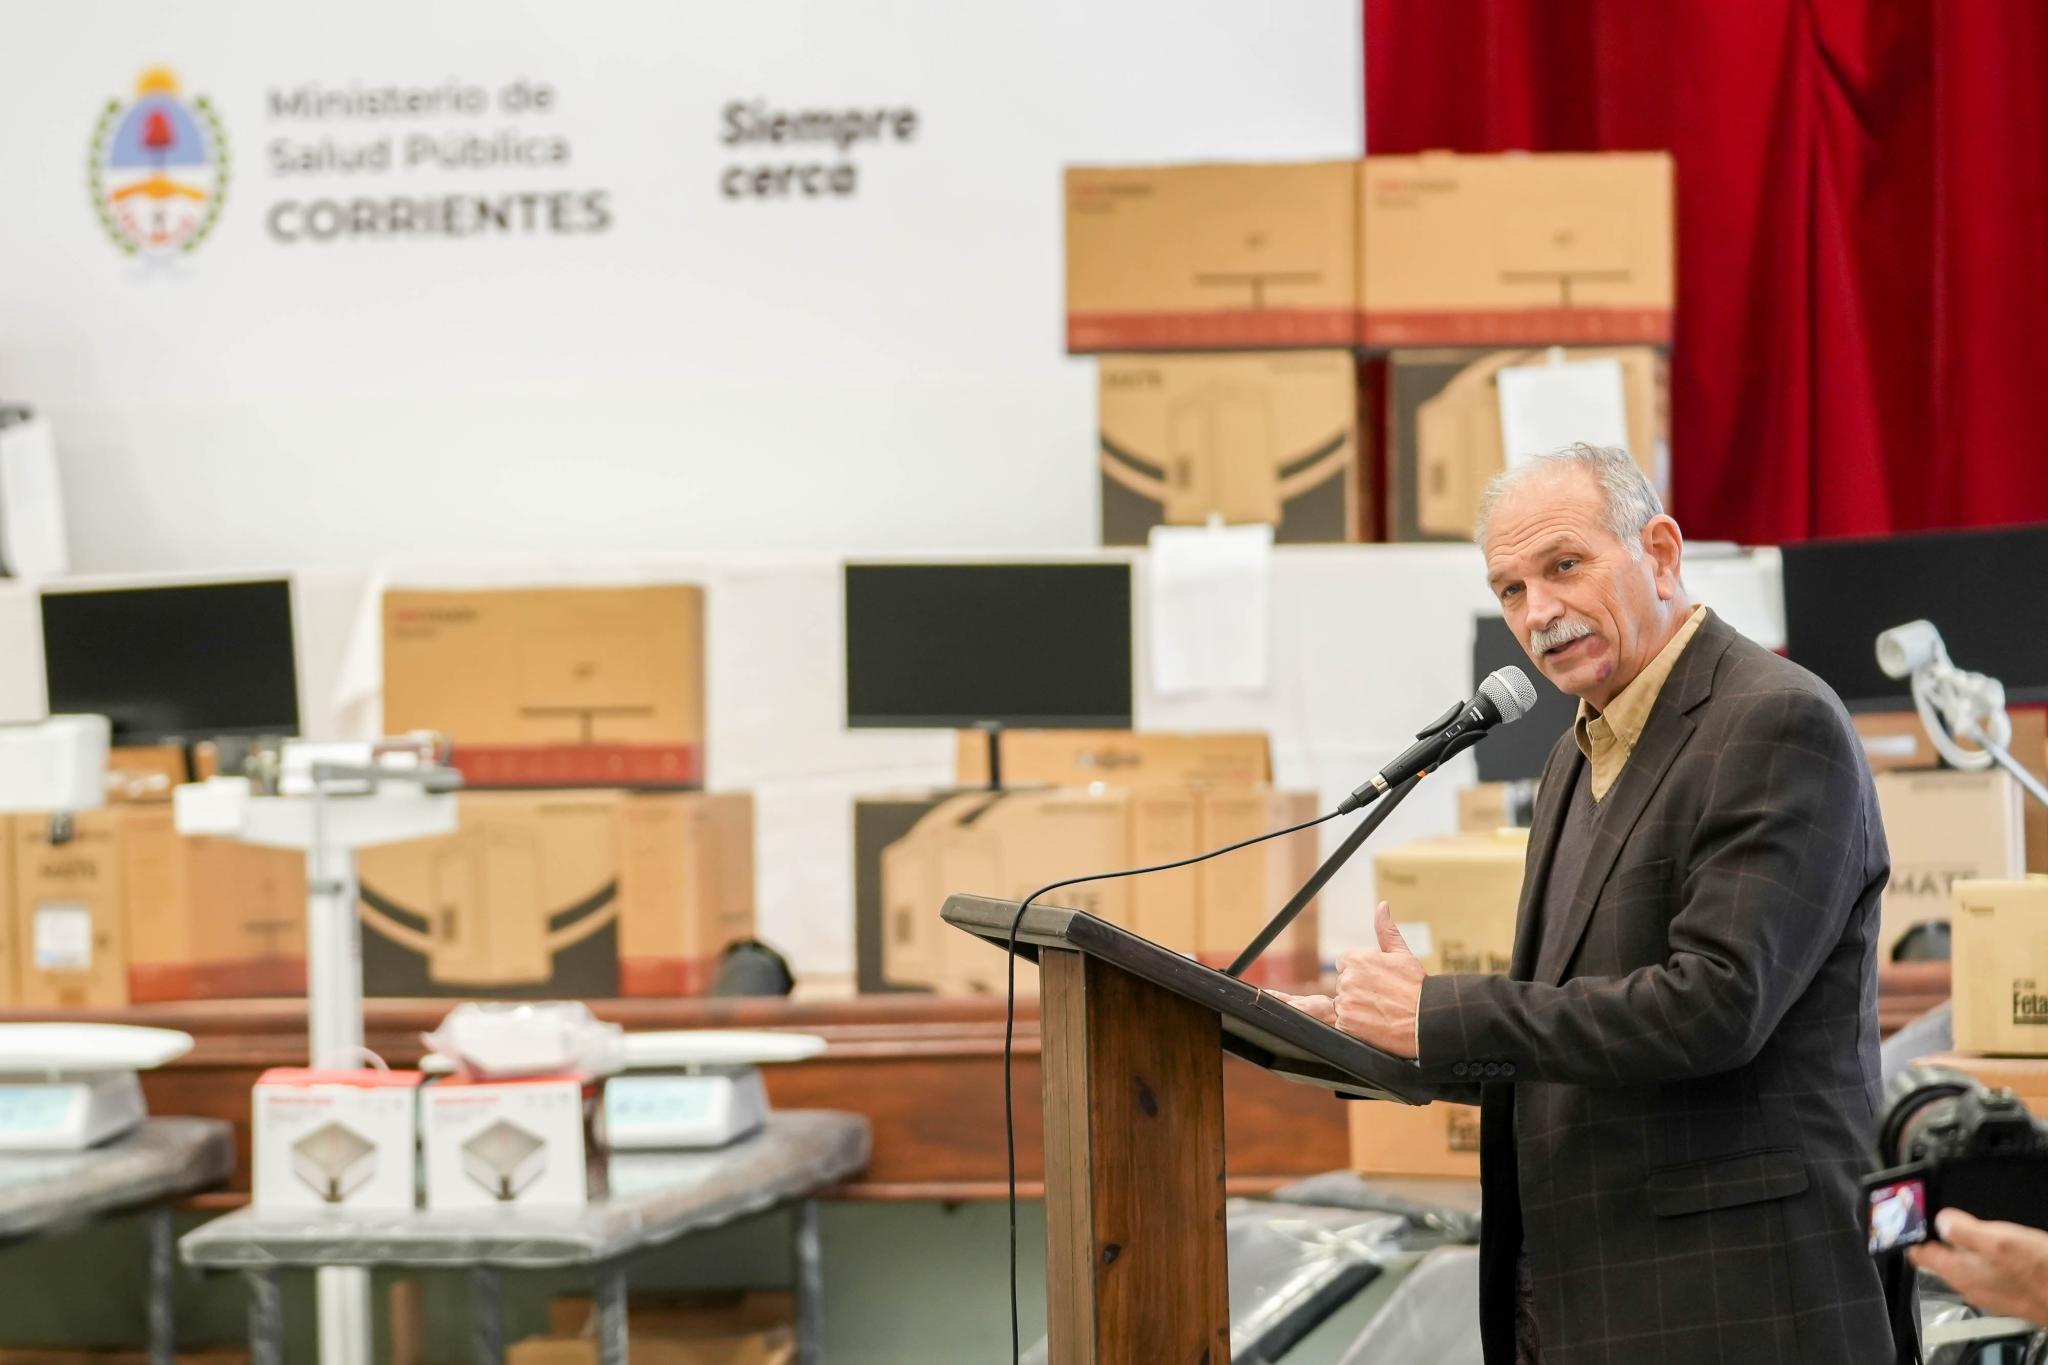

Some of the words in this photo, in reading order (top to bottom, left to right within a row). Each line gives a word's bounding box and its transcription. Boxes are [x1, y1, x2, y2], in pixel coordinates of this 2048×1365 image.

[267, 84, 489, 119] Ministerio
[498, 80, 556, 114] de
[720, 99, 921, 157] Siempre
[267, 137, 393, 176] Salud
[719, 161, 860, 201] cerca
[266, 189, 613, 243] CORRIENTES
